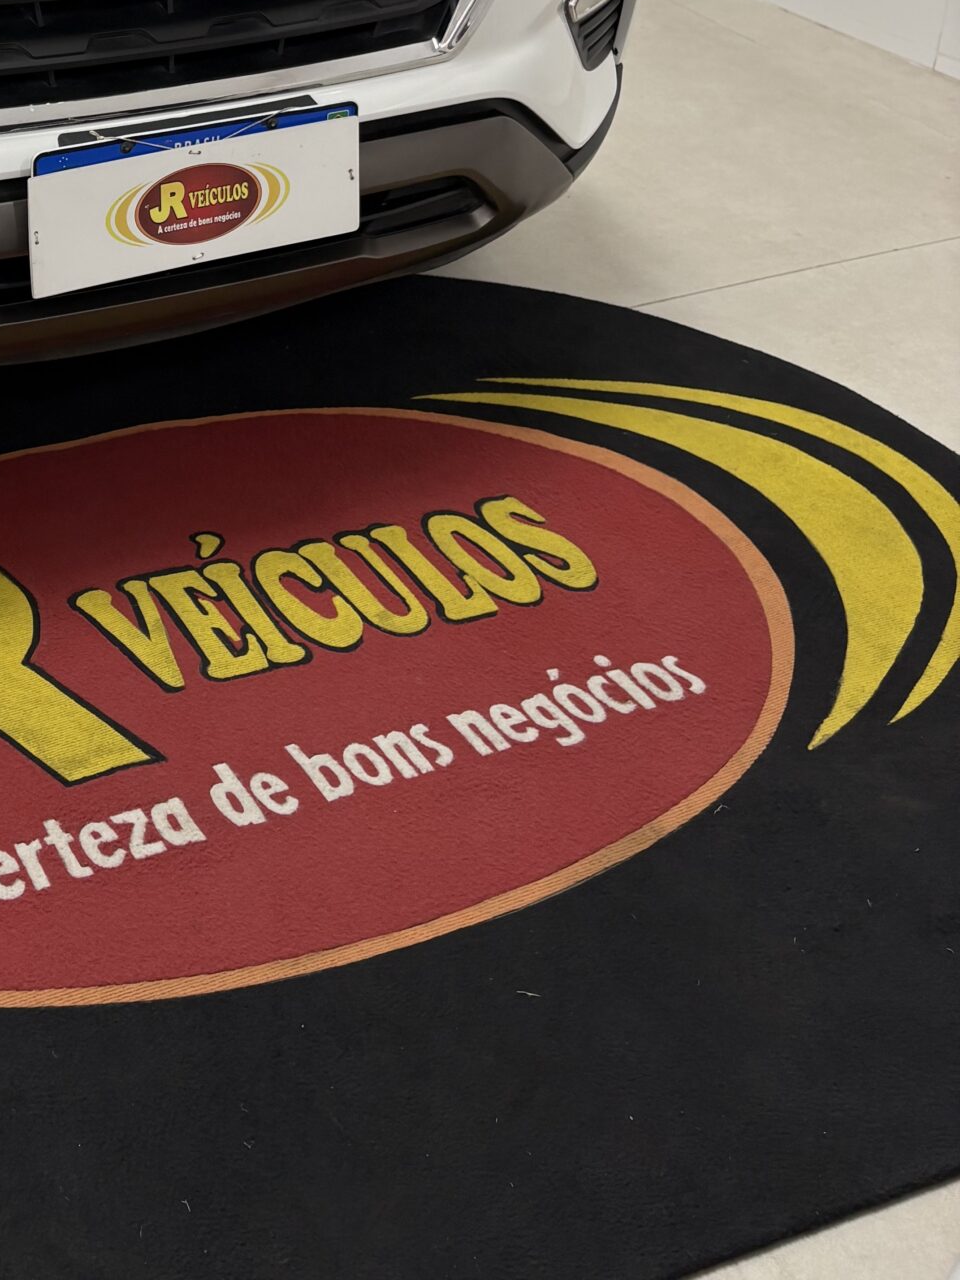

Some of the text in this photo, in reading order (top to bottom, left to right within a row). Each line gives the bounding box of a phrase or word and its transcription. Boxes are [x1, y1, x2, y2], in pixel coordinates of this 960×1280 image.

[149, 181, 248, 224] JR VEÍCULOS
[157, 211, 241, 234] A certeza de bons negócios
[70, 495, 598, 693] VEÍCULOS
[210, 763, 298, 827] de
[288, 721, 453, 802] bons
[447, 650, 708, 756] negócios
